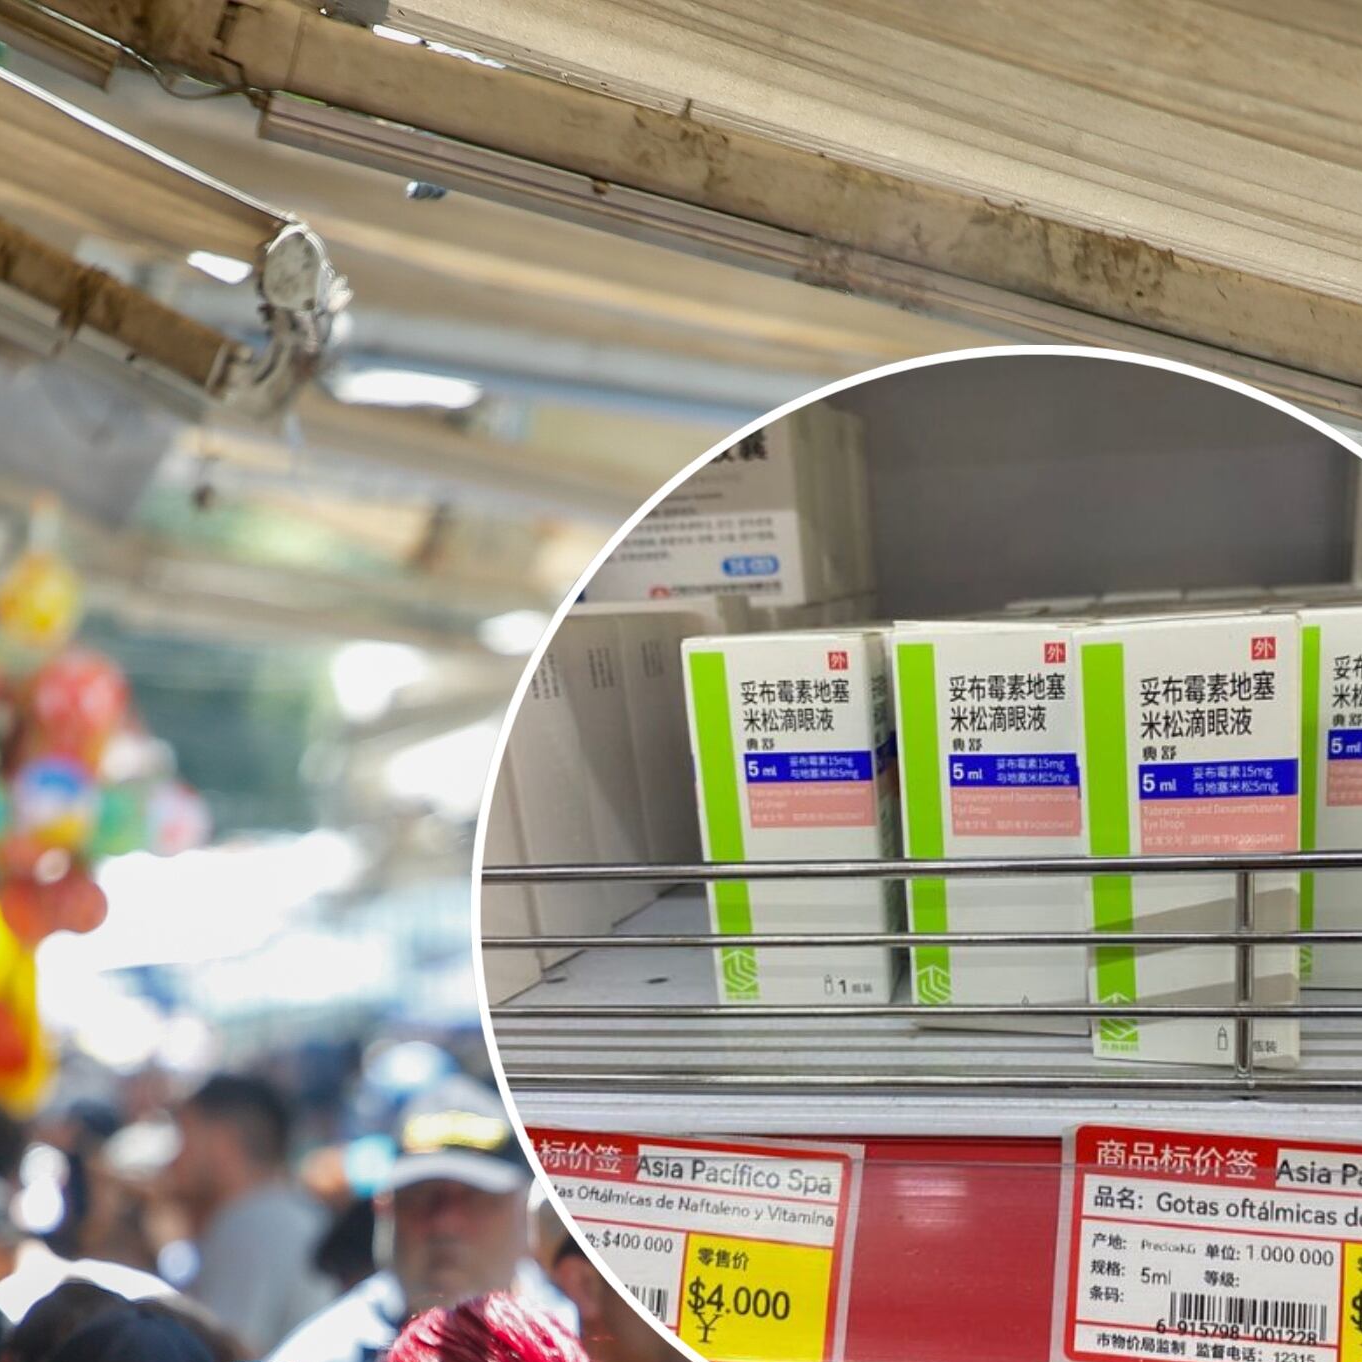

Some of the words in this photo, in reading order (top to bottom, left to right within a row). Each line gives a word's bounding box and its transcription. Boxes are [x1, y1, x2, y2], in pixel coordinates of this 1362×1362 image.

[828, 652, 848, 670] 外
[1045, 643, 1066, 663] 外
[1252, 638, 1275, 660] 外
[741, 679, 850, 705] 妥布霉素地塞
[949, 673, 1066, 702] 妥布霉素地塞
[1140, 670, 1275, 707] 妥布霉素地塞
[743, 708, 835, 732] 米松滴眼液
[950, 705, 1047, 732] 米松滴眼液
[1141, 707, 1253, 740] 米松滴眼液
[1331, 738, 1343, 754] 5
[748, 761, 759, 776] 5
[953, 763, 964, 779] 5
[1143, 773, 1155, 792] 5
[838, 979, 847, 994] 1
[1095, 1139, 1258, 1181] 商品标价签
[1276, 1159, 1332, 1185] Asia
[637, 1155, 683, 1180] Asia
[691, 1158, 780, 1189] Pacífico
[787, 1168, 832, 1196] Spa
[655, 1194, 675, 1210] de
[678, 1196, 750, 1218] Naftaleno
[753, 1208, 765, 1221] y
[767, 1205, 834, 1228] Vitamina
[1156, 1192, 1219, 1217] Gotas
[1226, 1197, 1337, 1226] oftálmicas
[697, 1246, 750, 1271] 零售价
[1140, 1266, 1172, 1286] 5ml
[687, 1276, 791, 1320] $4.000
[1156, 1318, 1167, 1335] 6
[1177, 1321, 1241, 1342] 915798
[1253, 1326, 1318, 1347] 001228
